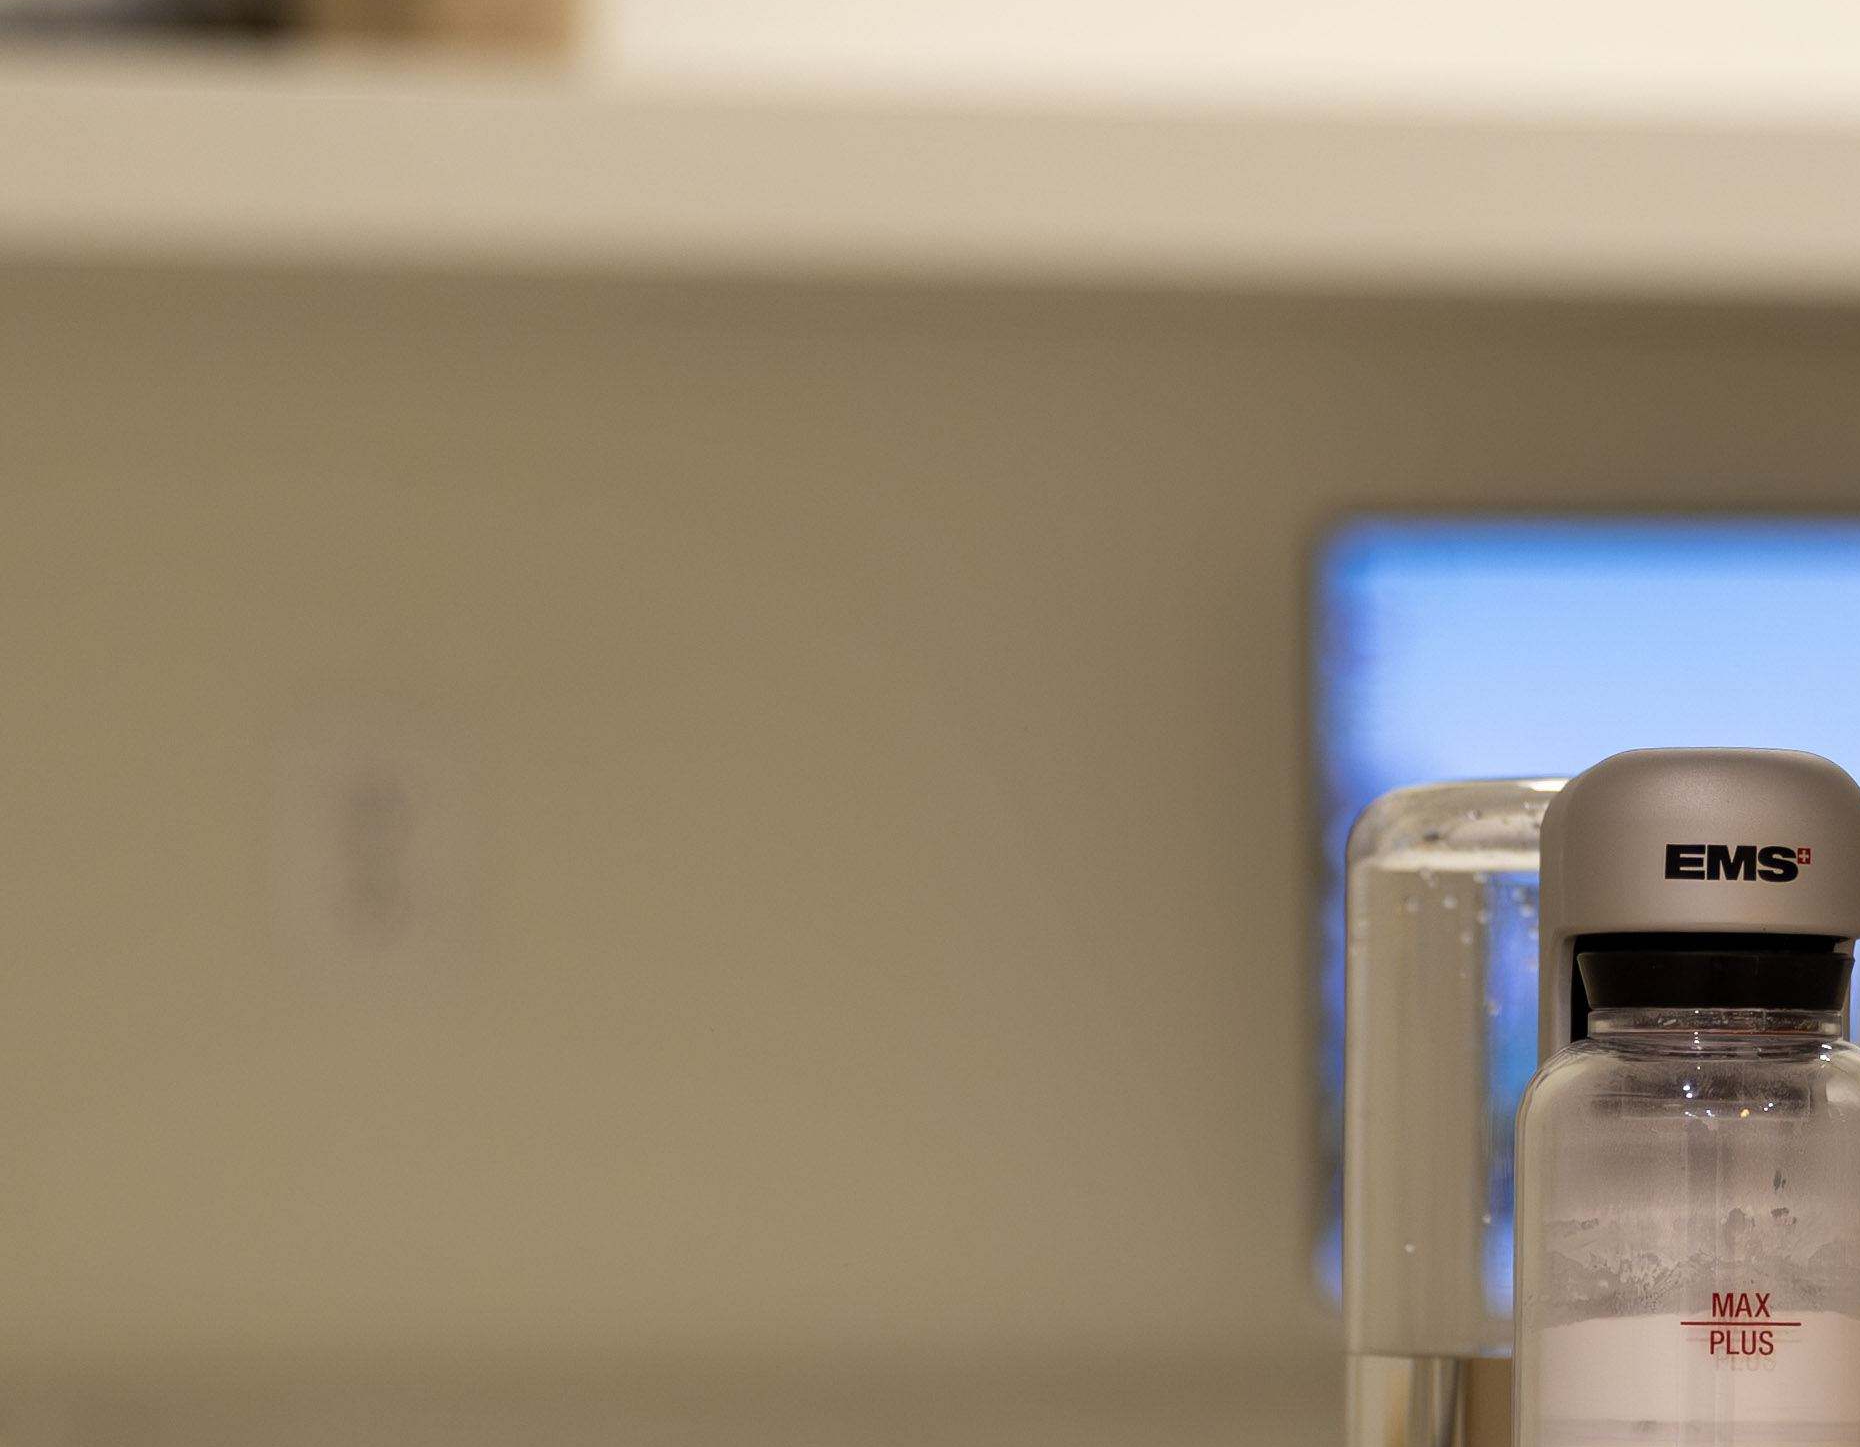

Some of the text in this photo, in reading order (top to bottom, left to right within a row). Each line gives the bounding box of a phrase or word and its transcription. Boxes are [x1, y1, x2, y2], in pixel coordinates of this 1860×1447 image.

[1665, 844, 1799, 883] EMS
[1712, 1293, 1770, 1318] MAX
[1710, 1330, 1774, 1355] PLUS
